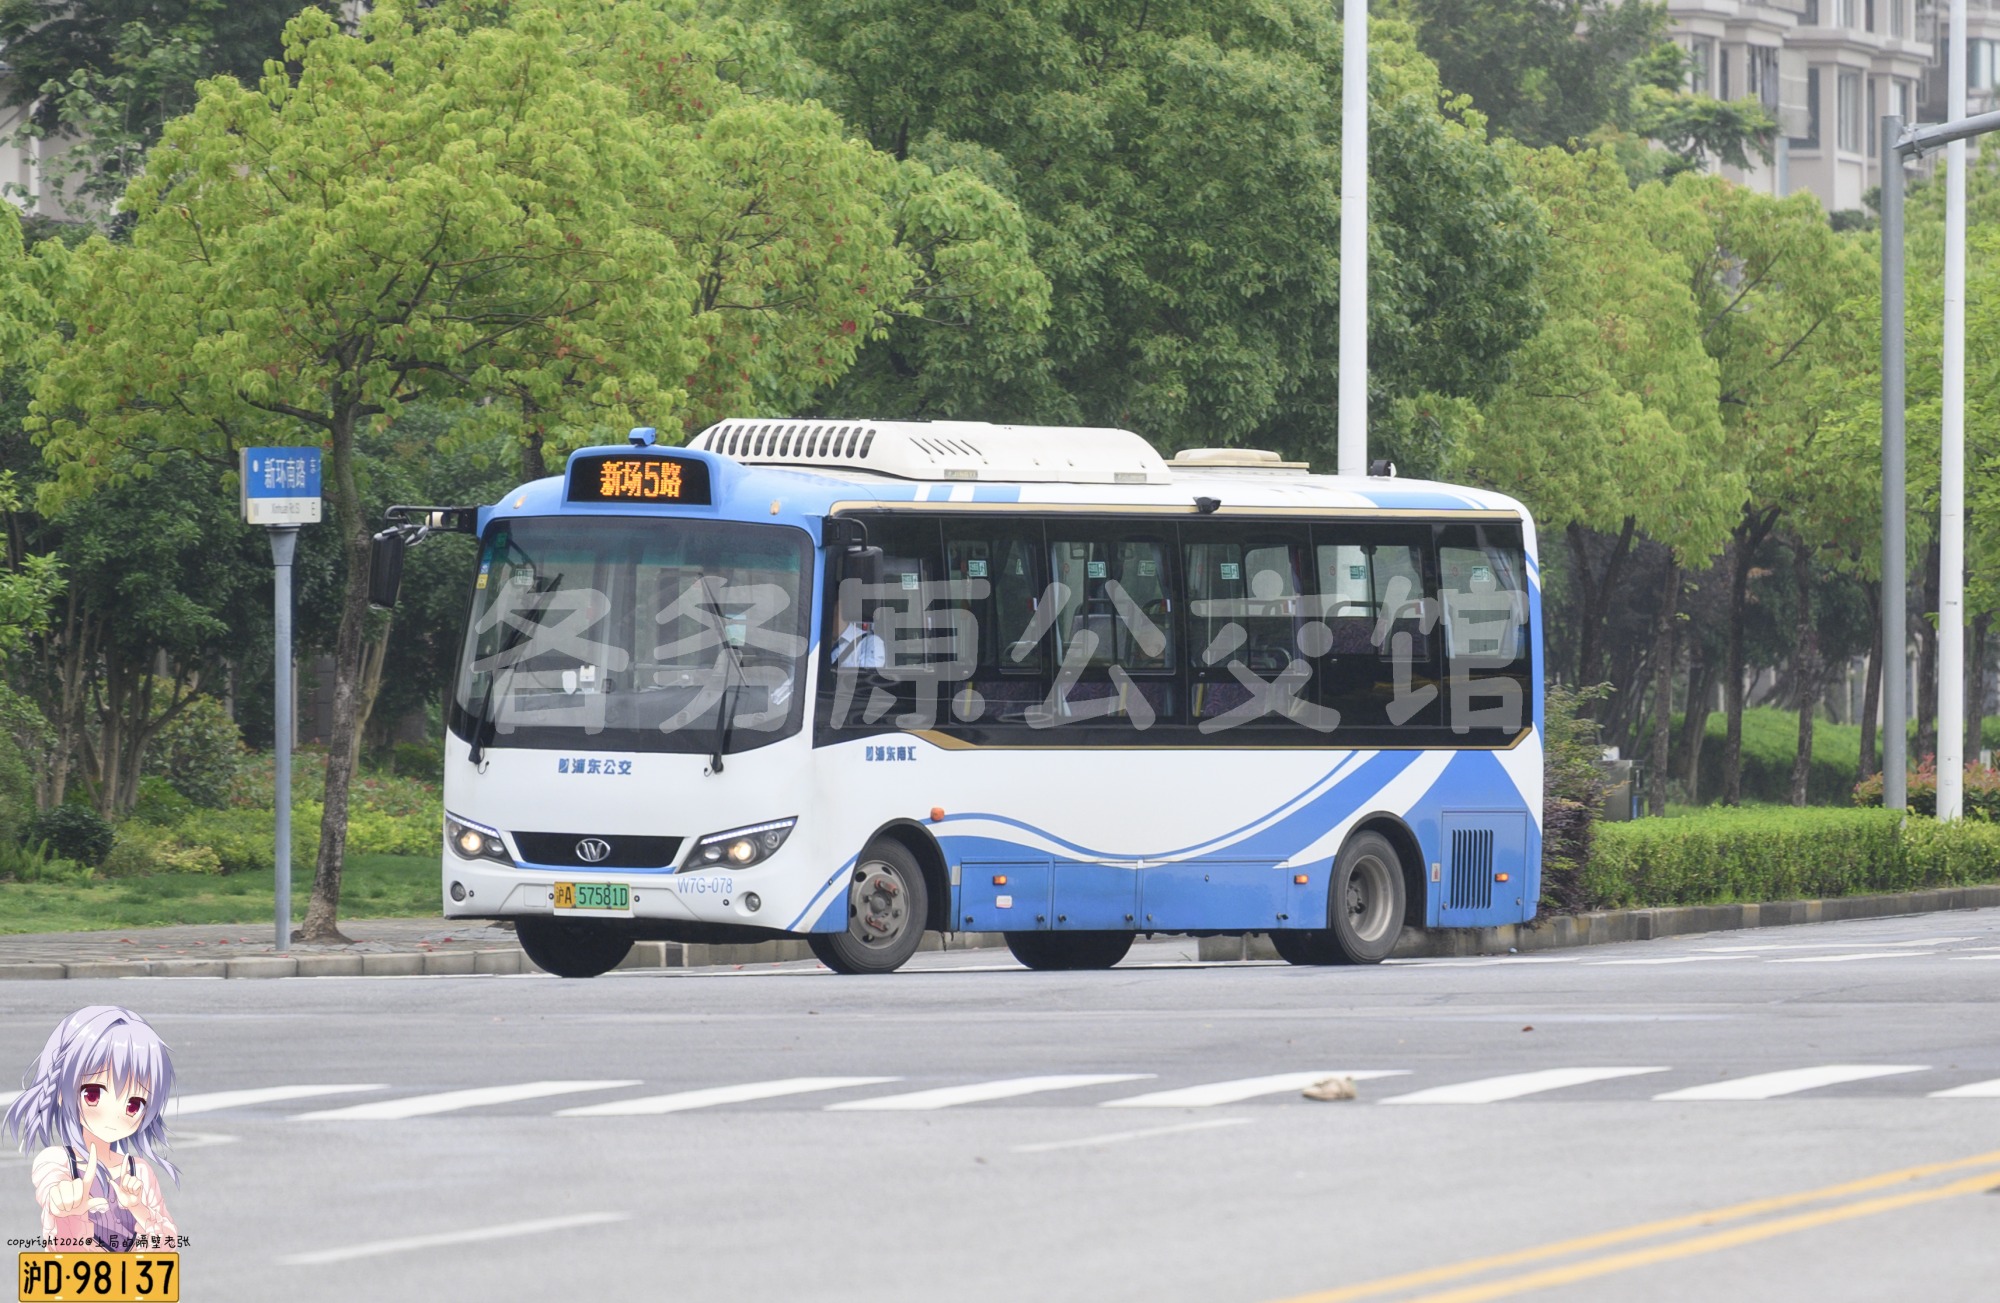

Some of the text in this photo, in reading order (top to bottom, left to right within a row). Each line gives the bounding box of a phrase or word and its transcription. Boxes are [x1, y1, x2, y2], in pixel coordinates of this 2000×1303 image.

[264, 457, 306, 488] 新环南路
[600, 461, 682, 497] 新场5路
[875, 746, 917, 761] 浦东南汇
[571, 758, 632, 775] 浦东公交
[677, 877, 733, 894] W7G-078
